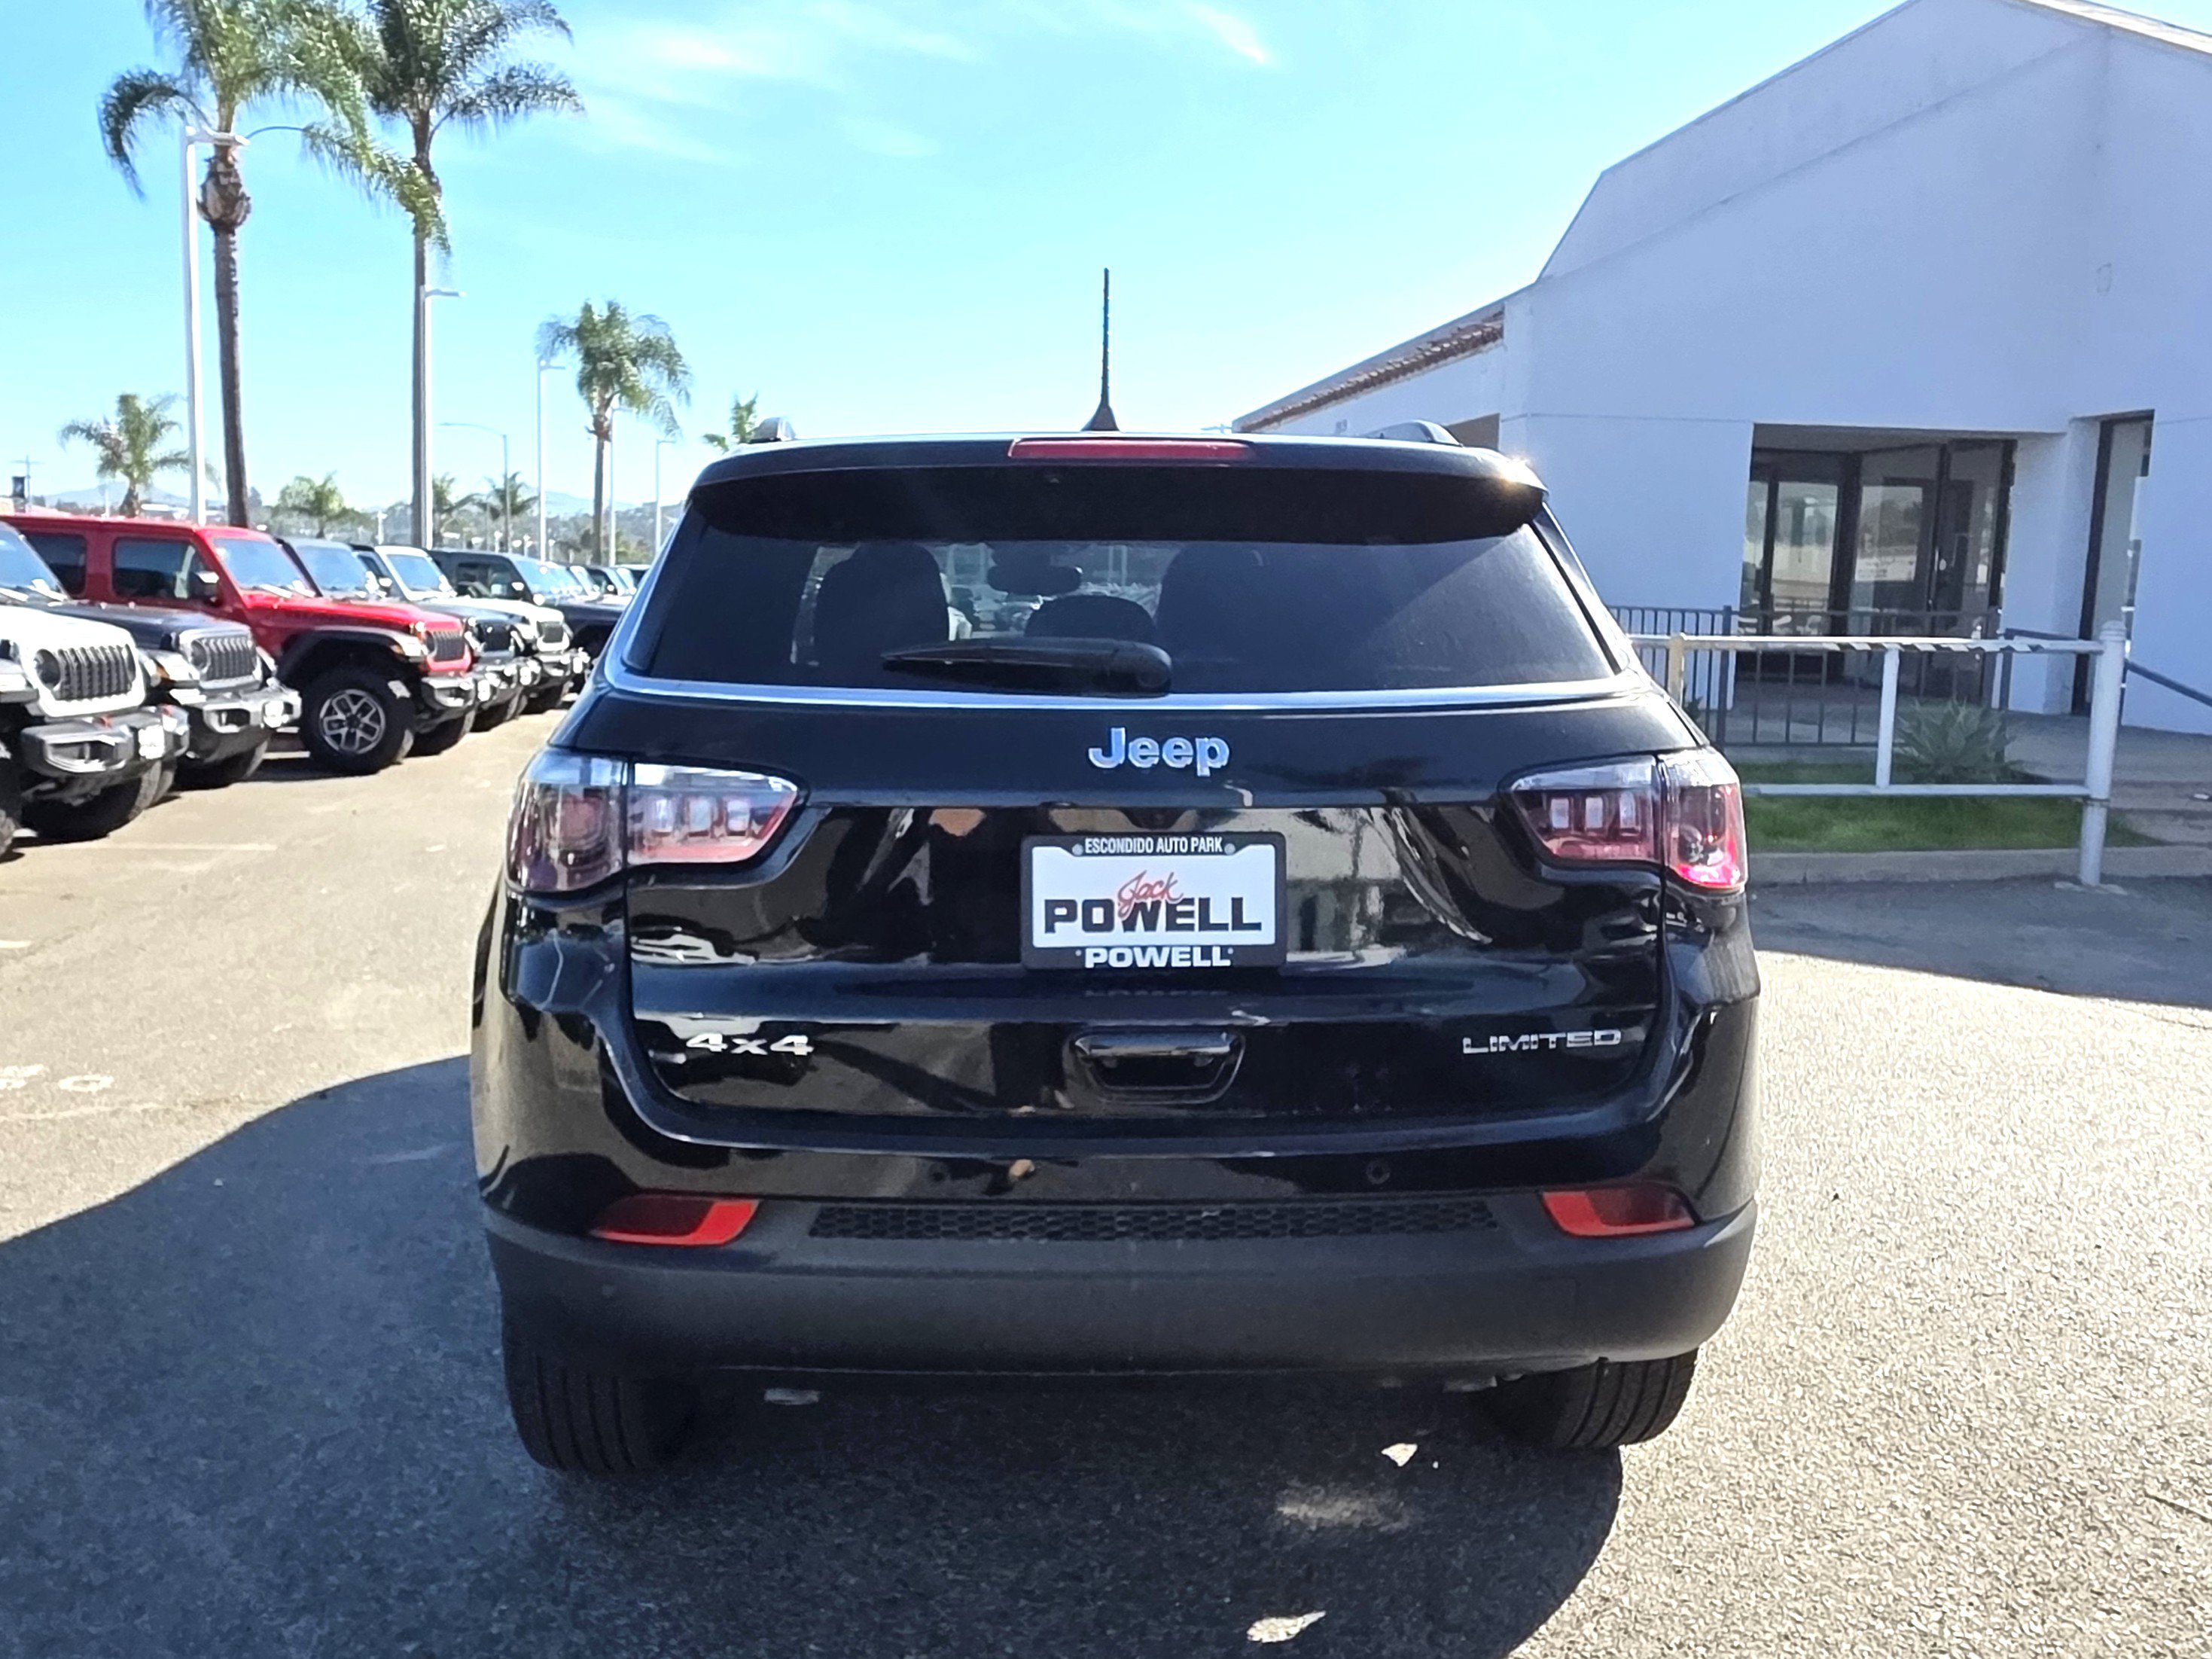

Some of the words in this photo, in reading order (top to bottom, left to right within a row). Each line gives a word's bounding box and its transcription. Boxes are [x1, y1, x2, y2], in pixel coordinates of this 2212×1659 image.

[1088, 727, 1230, 776] Jeep
[1085, 837, 1154, 854] ESCONDIDO
[1156, 837, 1189, 853] AUTO
[1190, 836, 1223, 852] PARK
[1117, 870, 1184, 919] Jack
[1044, 897, 1263, 934] POWELL
[1084, 946, 1232, 968] POWELL
[1462, 1029, 1622, 1054] LIMITED
